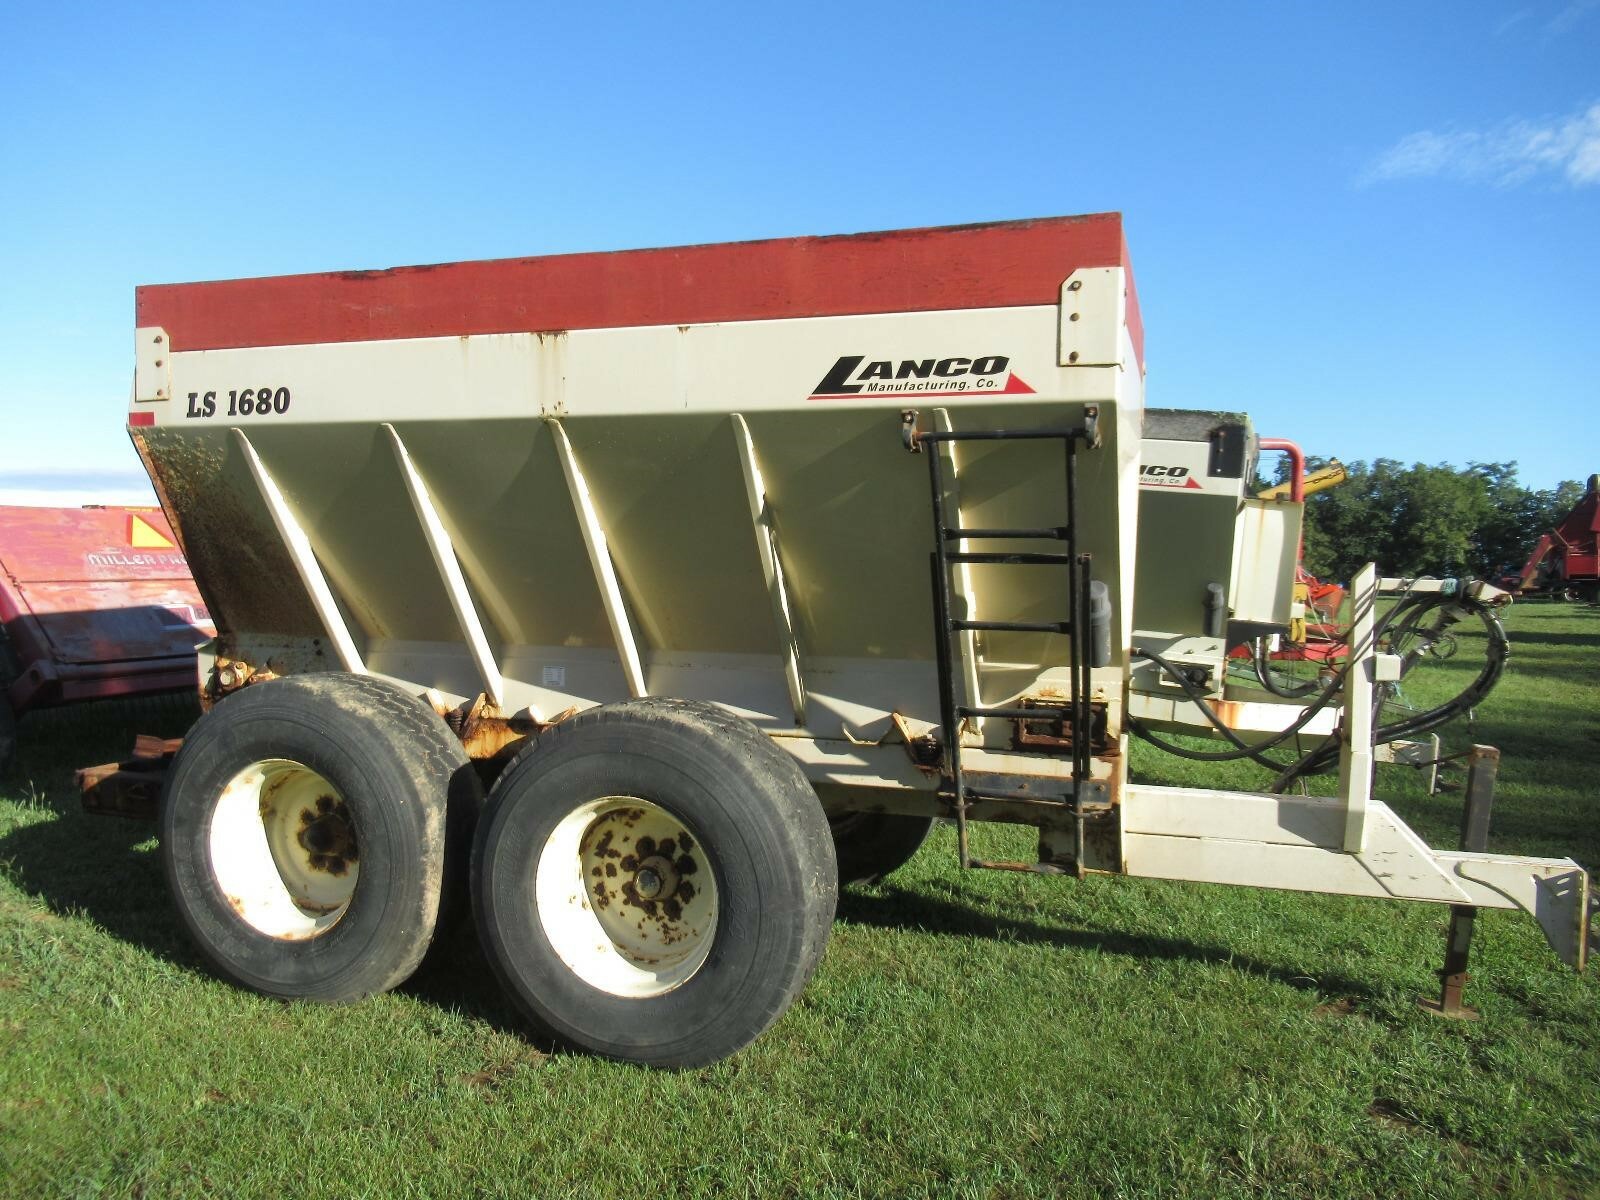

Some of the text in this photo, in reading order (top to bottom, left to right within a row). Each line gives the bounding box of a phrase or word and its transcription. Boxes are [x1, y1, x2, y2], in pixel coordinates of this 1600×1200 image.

[811, 355, 1010, 395] LANCO
[867, 378, 999, 393] Manufacturing, Co.
[186, 386, 291, 418] LS 1680
[87, 553, 157, 566] MILLER
